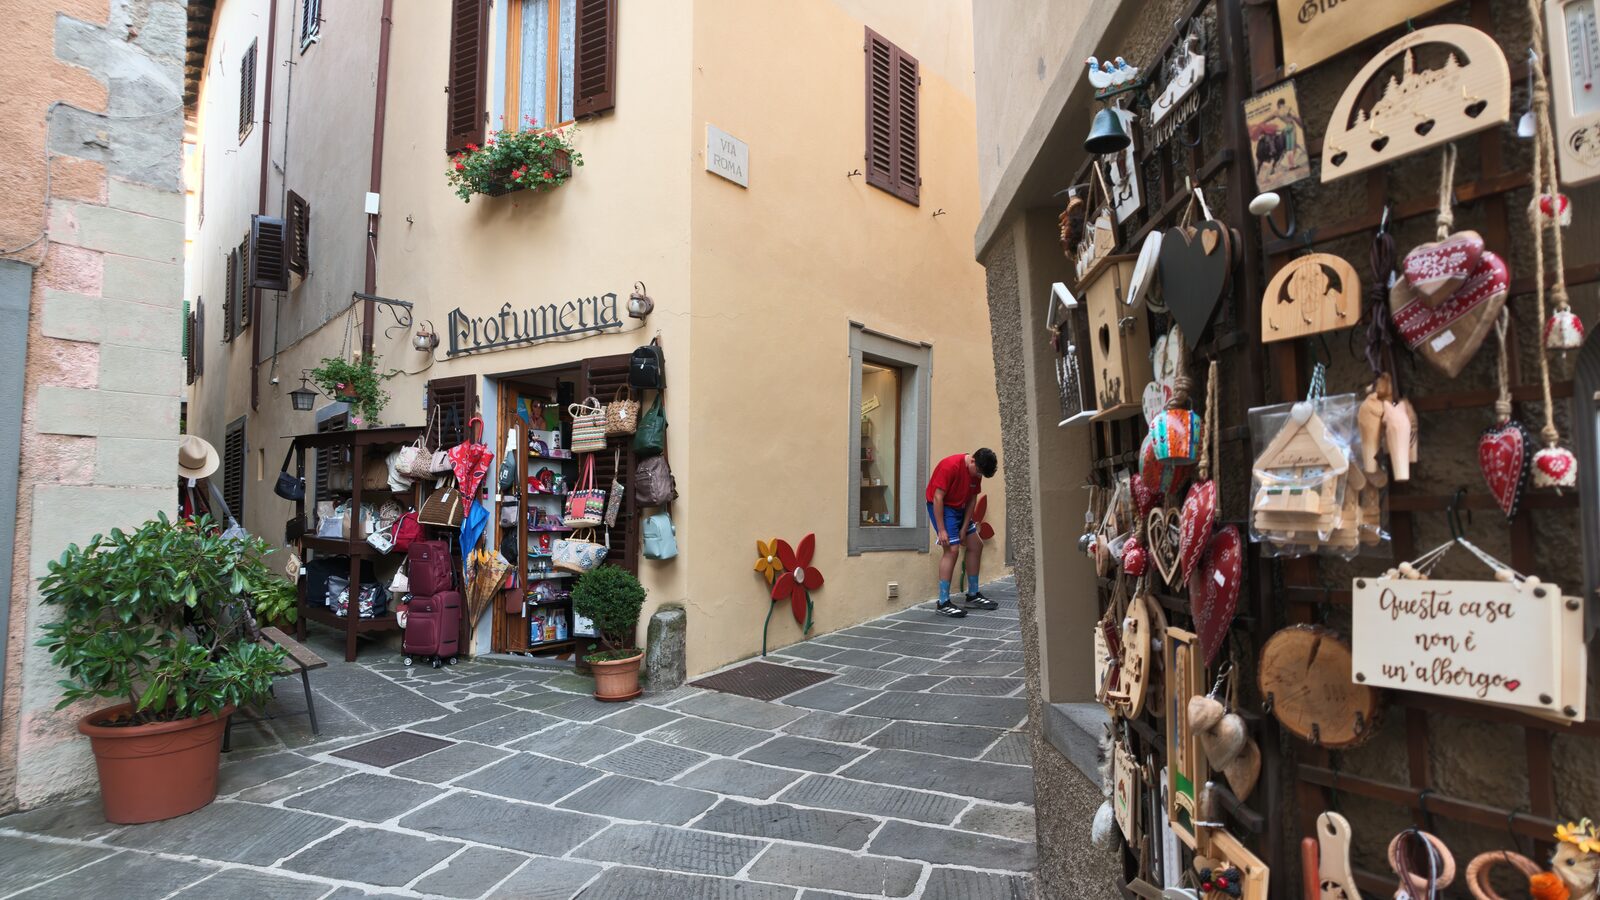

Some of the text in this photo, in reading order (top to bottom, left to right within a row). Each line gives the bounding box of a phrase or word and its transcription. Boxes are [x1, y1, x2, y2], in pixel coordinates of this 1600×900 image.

[720, 138, 737, 157] VIA
[713, 153, 743, 177] ROMA
[447, 292, 619, 352] Profumeria
[1379, 587, 1515, 623] Questa casa
[1415, 631, 1476, 653] non è
[1382, 658, 1507, 698] un'albergo
